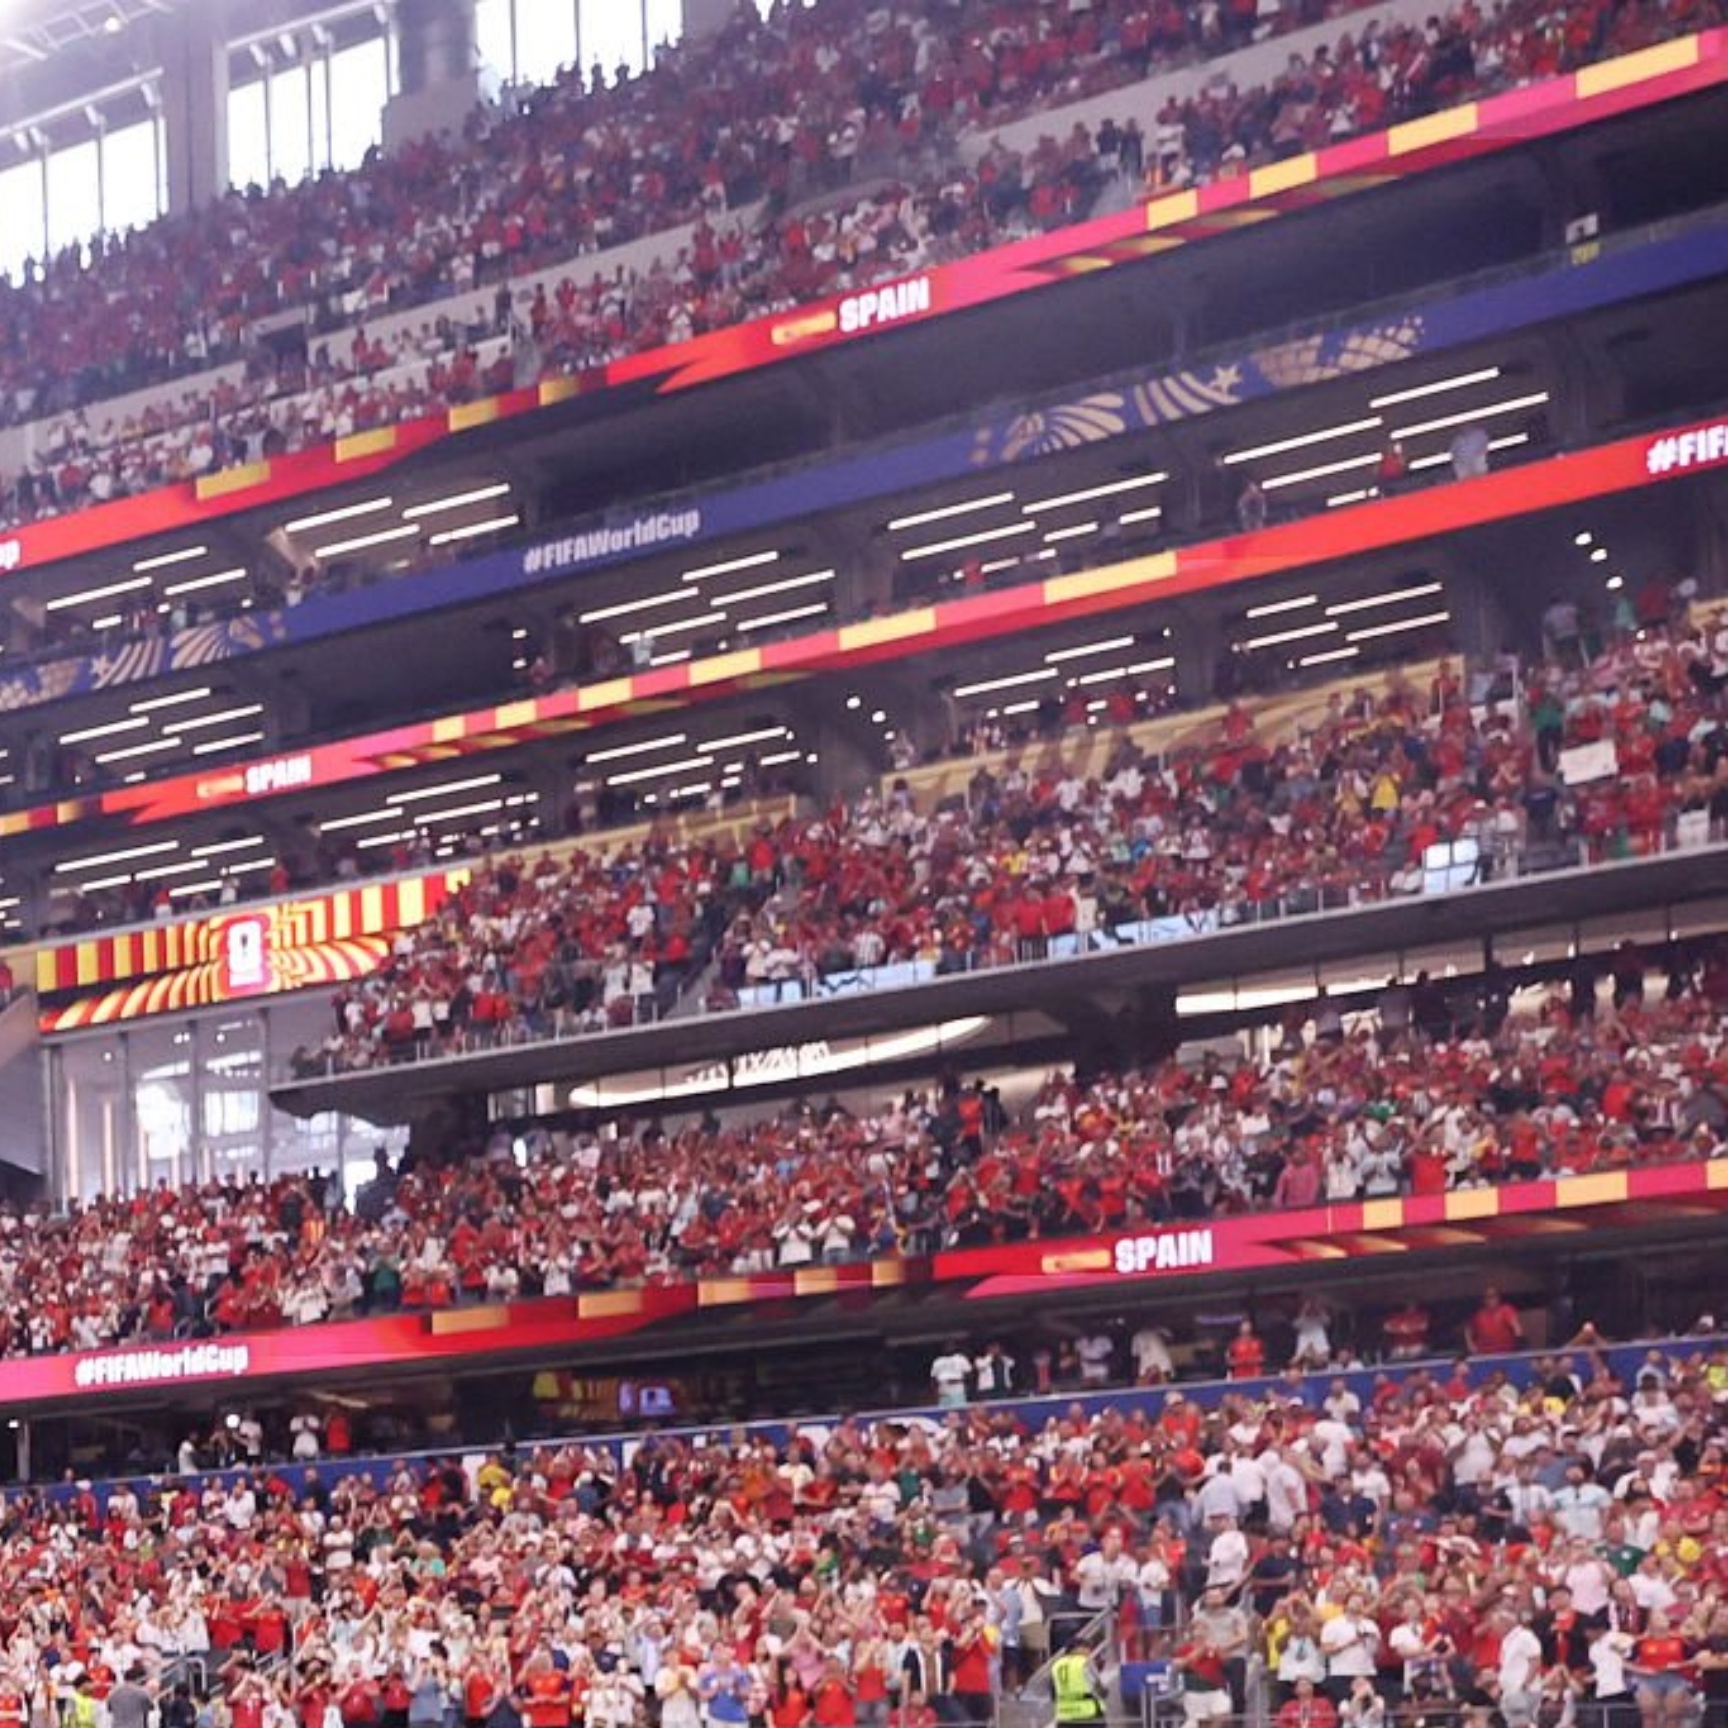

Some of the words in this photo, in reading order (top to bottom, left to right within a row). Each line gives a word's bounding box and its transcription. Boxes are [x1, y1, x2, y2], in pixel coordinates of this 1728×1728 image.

[839, 276, 929, 333] SPAIN
[1647, 425, 1728, 474] #FIF
[523, 508, 700, 573] #FIFAWorldCup
[246, 754, 311, 794] SPAIN
[1115, 1229, 1213, 1273] SPAIN
[75, 1344, 249, 1387] #FIFAWorldCup
